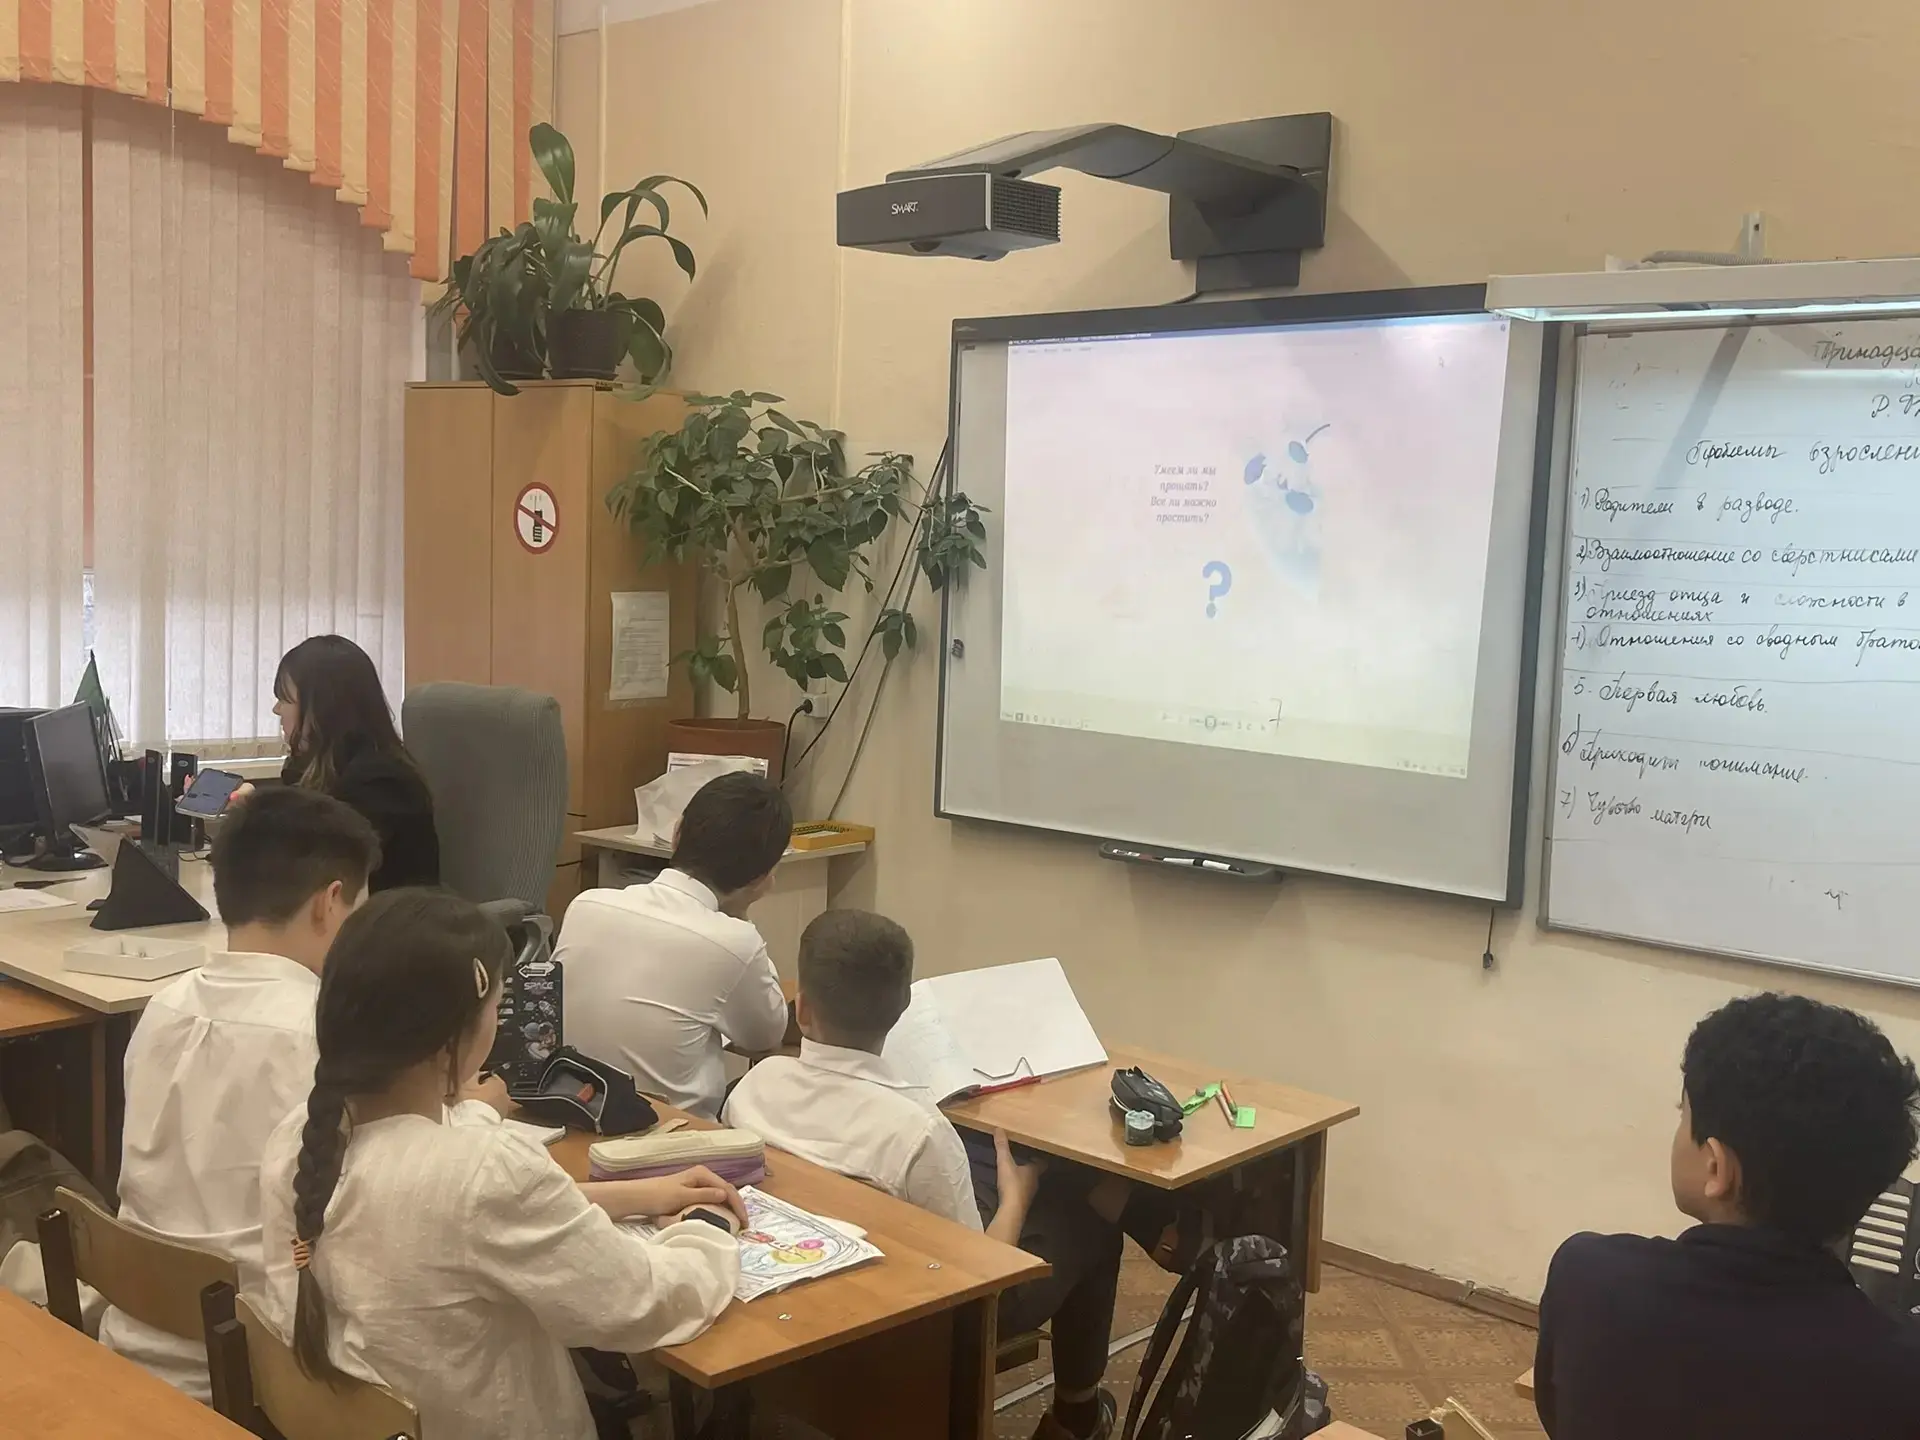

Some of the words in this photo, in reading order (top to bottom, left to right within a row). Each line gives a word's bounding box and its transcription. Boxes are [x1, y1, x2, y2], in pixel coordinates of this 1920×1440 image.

[891, 201, 919, 215] SMART
[1154, 464, 1184, 476] Умеем
[1186, 466, 1199, 476] ли
[1202, 466, 1217, 477] мы
[1168, 499, 1181, 508] ли
[1183, 499, 1218, 508] можно
[1594, 487, 1674, 523] Родители
[1696, 491, 1708, 512] в
[1716, 490, 1799, 525] разводе.
[1155, 513, 1210, 524] простить?
[1741, 549, 1762, 564] со
[1669, 590, 1723, 607] отца
[1897, 591, 1909, 607] в
[1726, 636, 1745, 647] со
[1756, 623, 1838, 661] сводным
[1855, 628, 1920, 668] брато
[1599, 670, 1679, 713] Первая
[523, 981, 554, 991] SPACE
